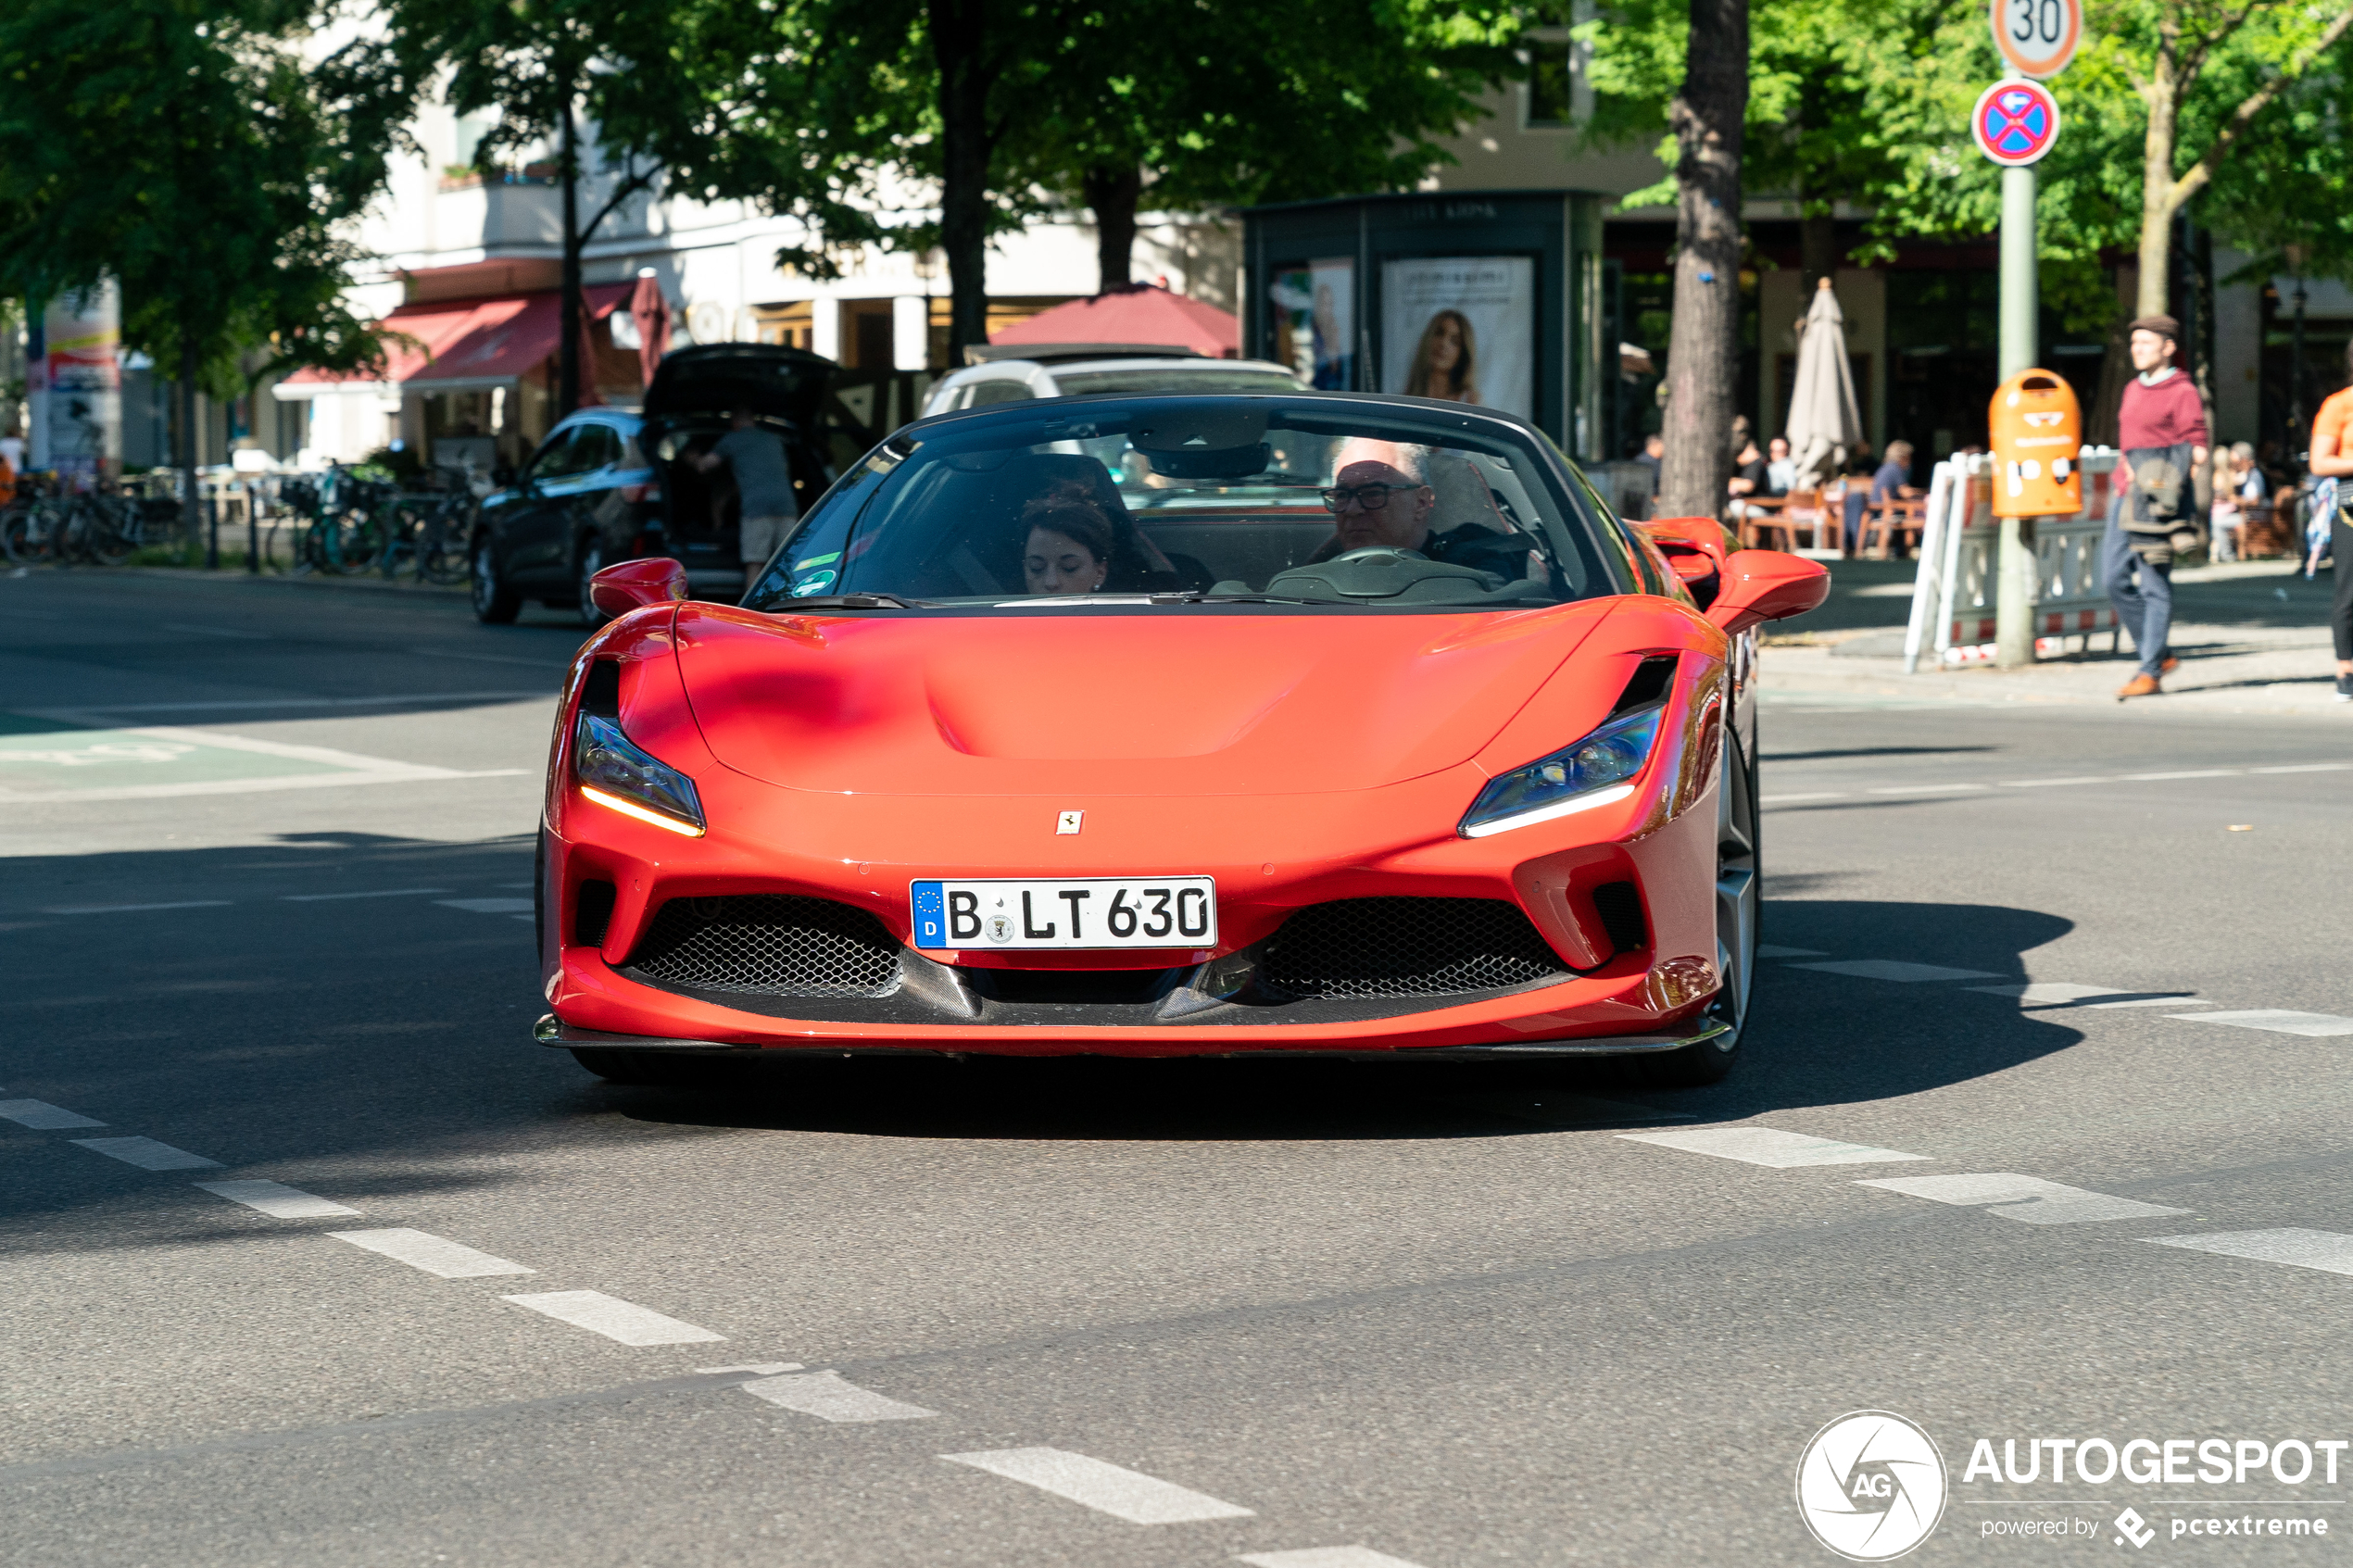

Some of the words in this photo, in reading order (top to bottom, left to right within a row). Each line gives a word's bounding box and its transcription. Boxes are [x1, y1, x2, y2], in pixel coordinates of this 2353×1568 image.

[2013, 0, 2060, 43] 30
[925, 922, 937, 936] D
[949, 891, 982, 939] B
[1023, 890, 1090, 939] LT
[1108, 888, 1208, 938] 630
